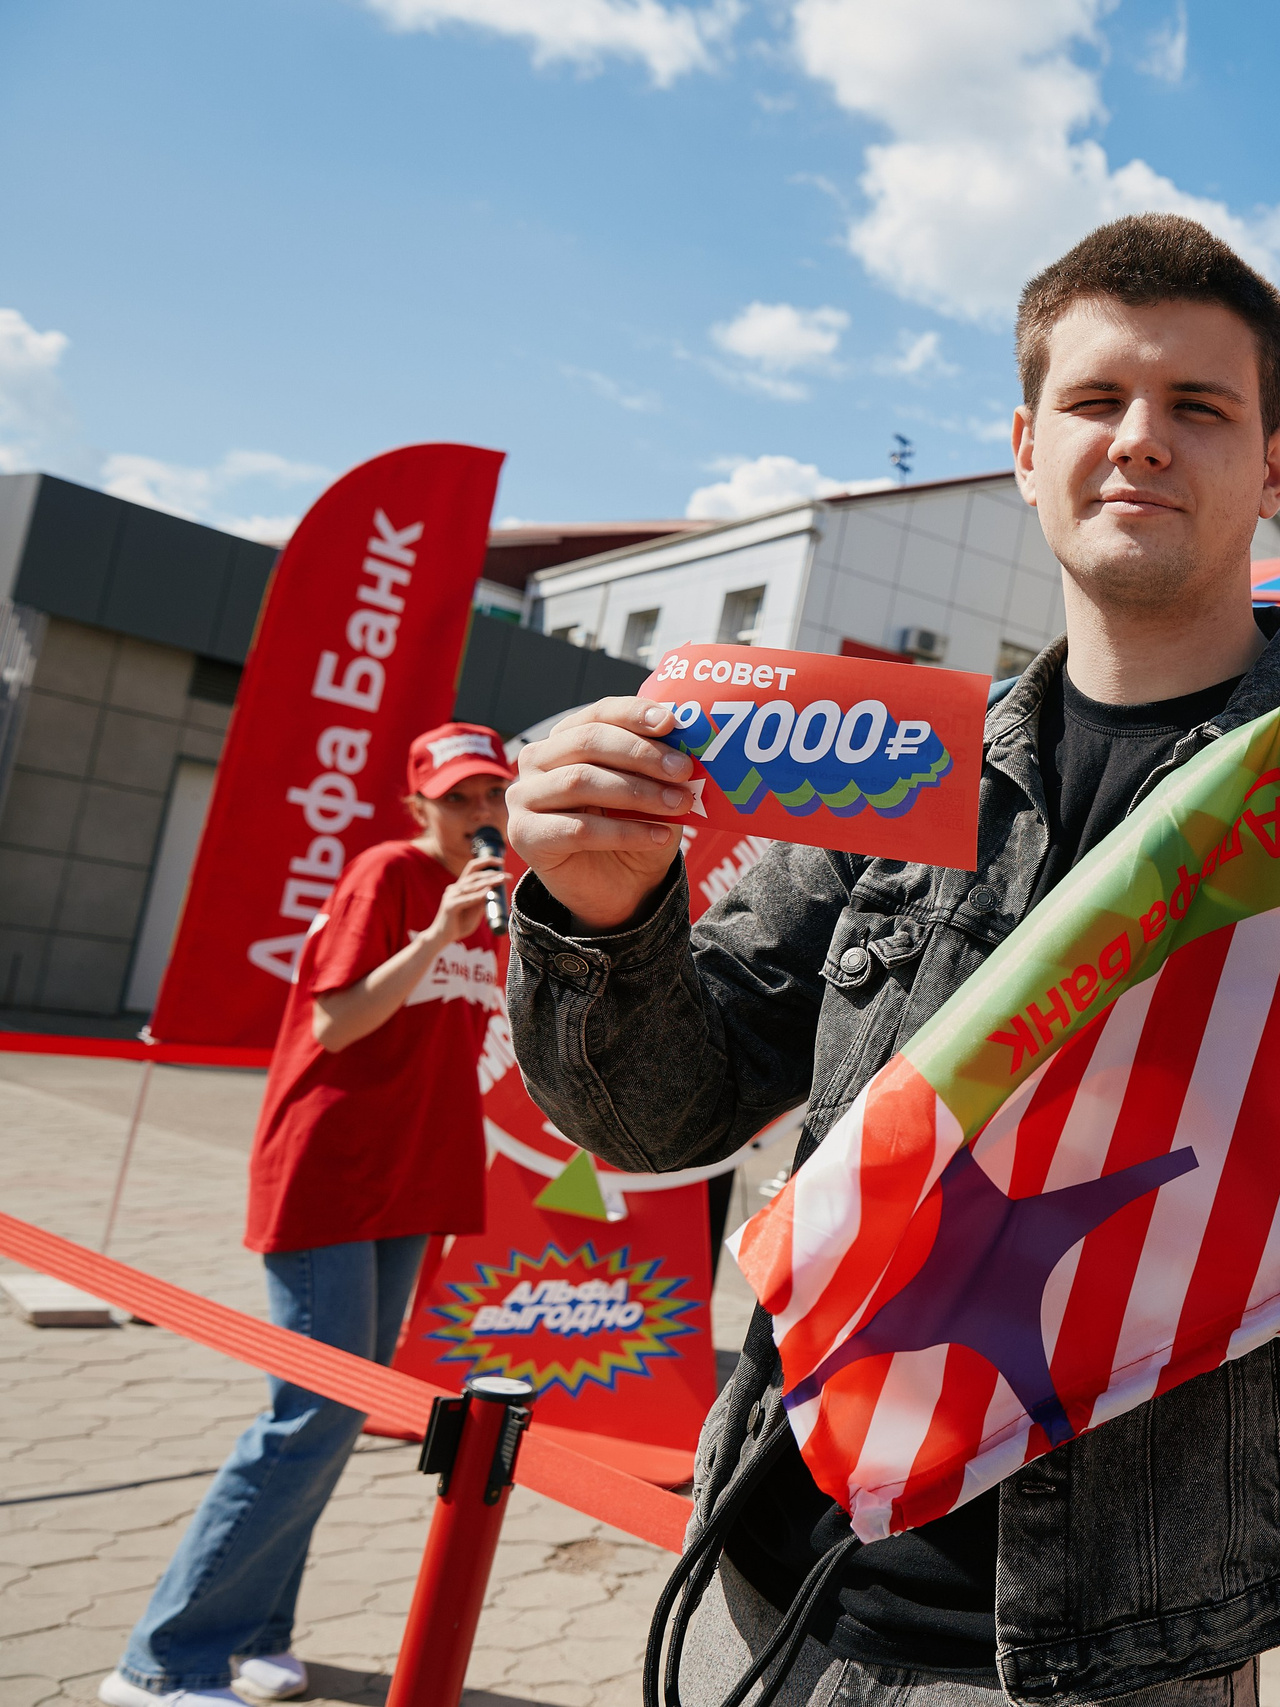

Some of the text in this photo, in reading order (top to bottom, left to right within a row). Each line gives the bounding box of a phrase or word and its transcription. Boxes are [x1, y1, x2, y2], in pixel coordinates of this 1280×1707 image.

[657, 655, 796, 691] За совет
[246, 507, 424, 984] Альфа Банк
[986, 931, 1132, 1076] Банк
[502, 1278, 629, 1305] АЛЬФА
[470, 1301, 645, 1335] ВЫГОДНО
